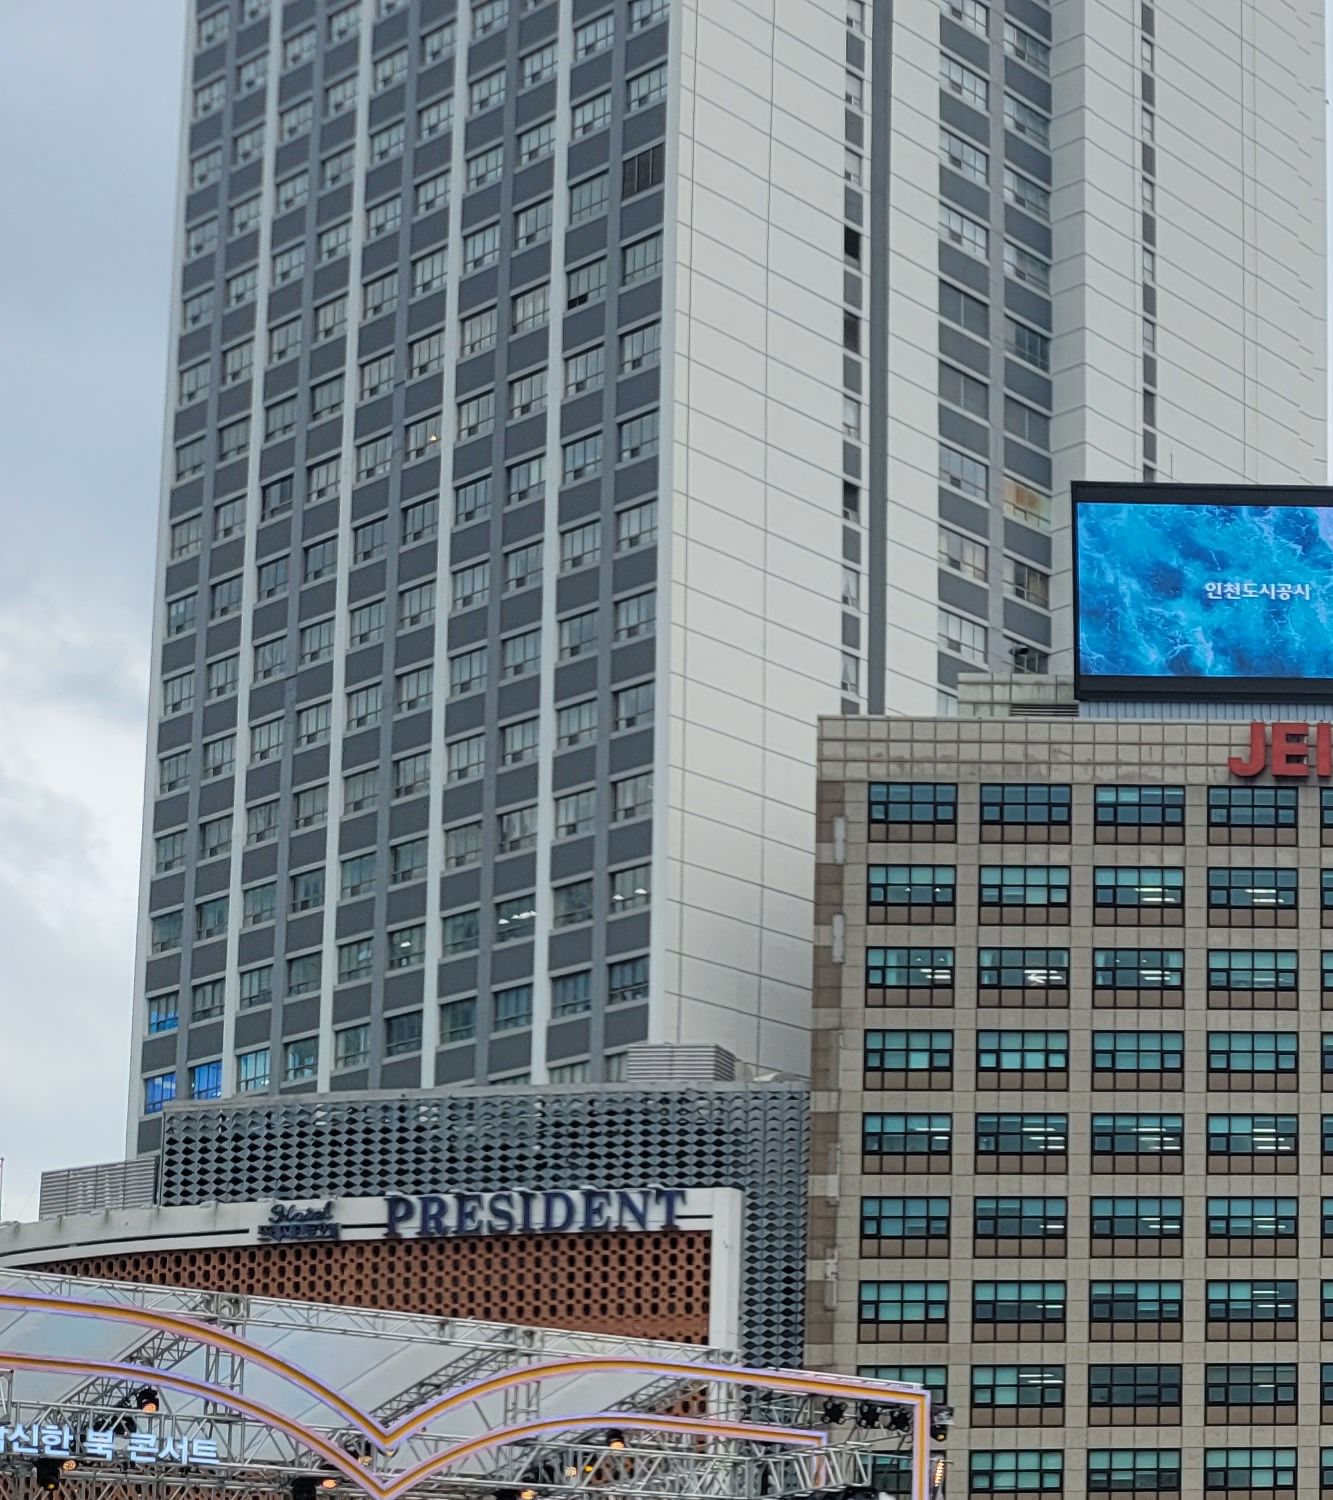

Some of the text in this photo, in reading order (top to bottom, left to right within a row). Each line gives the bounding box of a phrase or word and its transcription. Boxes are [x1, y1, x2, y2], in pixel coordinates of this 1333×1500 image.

[1228, 722, 1332, 777] JEI
[384, 1188, 687, 1239] PRESIDENT
[82, 1429, 115, 1461] 북
[128, 1433, 220, 1465] 콘서트
